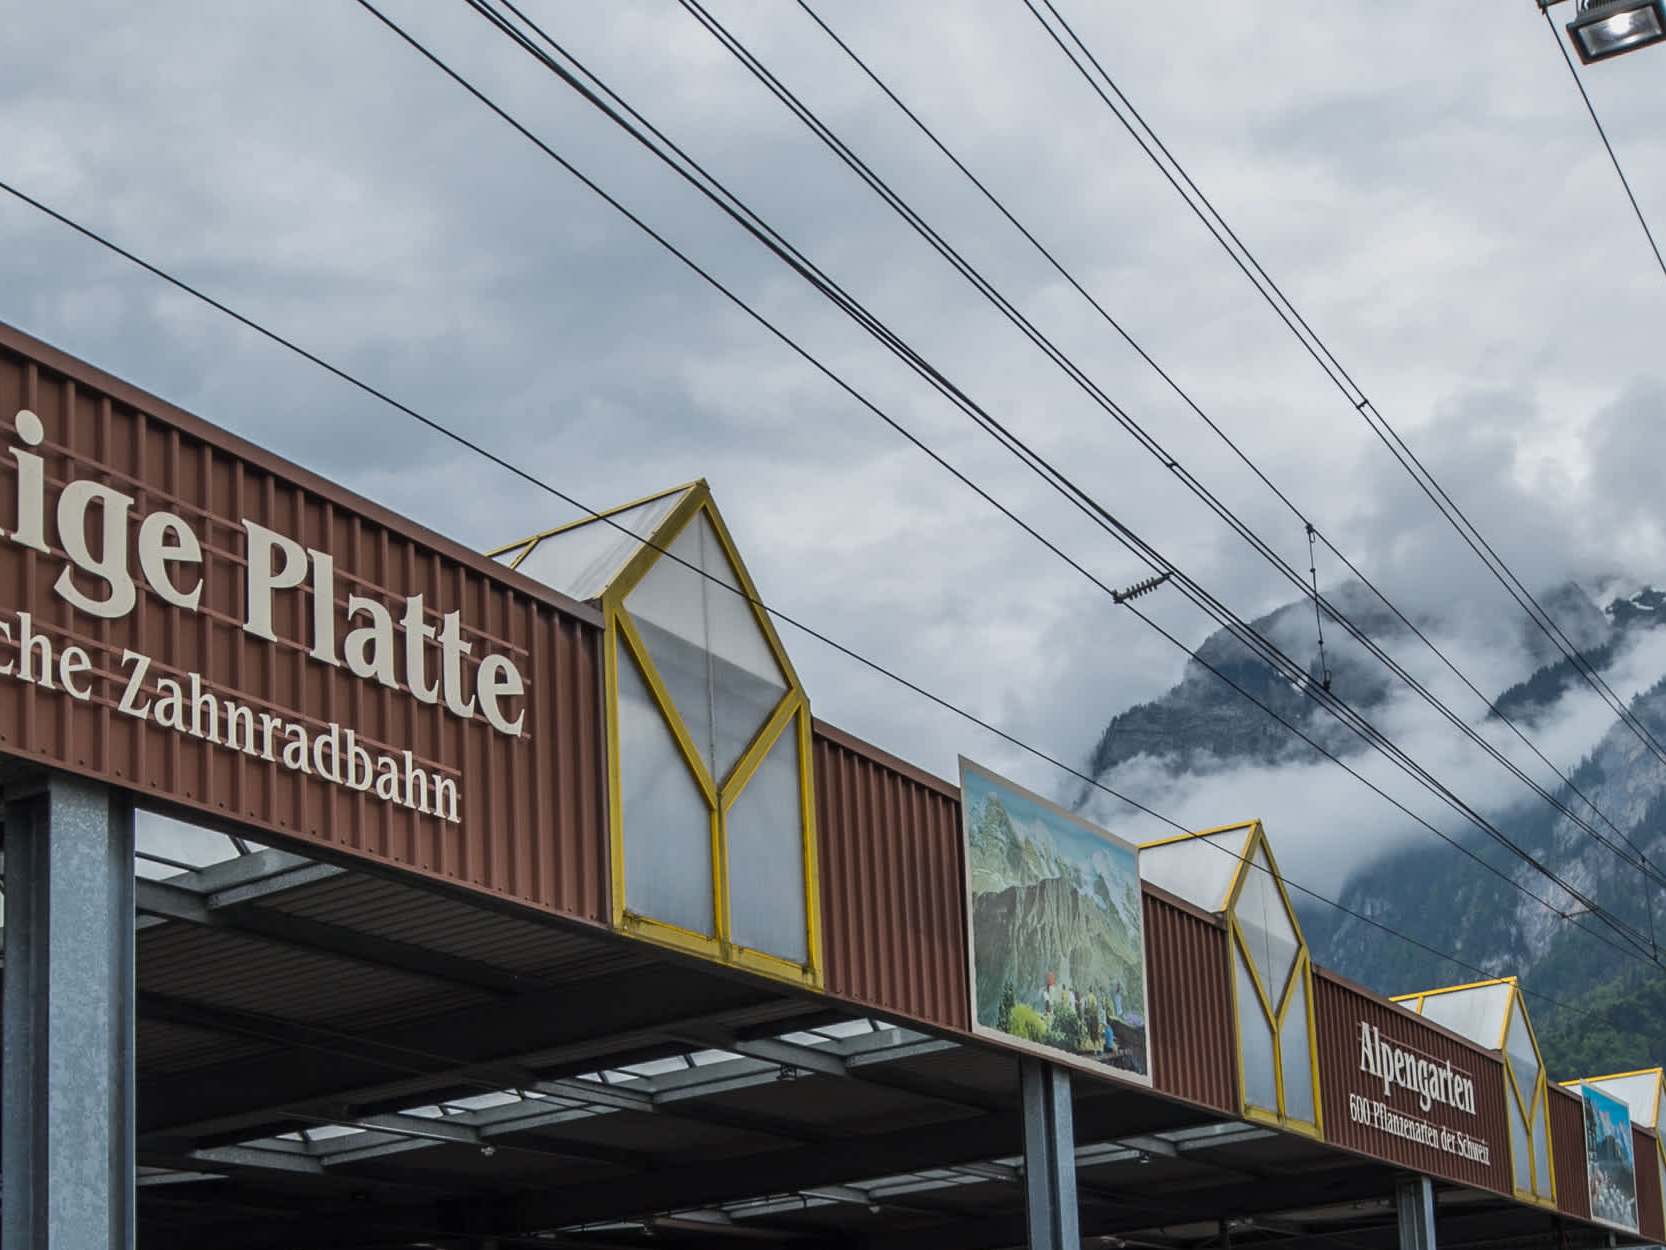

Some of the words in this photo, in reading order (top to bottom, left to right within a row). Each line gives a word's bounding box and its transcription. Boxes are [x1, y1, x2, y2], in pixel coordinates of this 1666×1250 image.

[241, 517, 527, 738] Platte
[118, 649, 462, 824] Zahnradbahn
[1349, 1093, 1371, 1126] 600
[1372, 1100, 1439, 1149] Pflanzenarten
[1440, 1125, 1456, 1154] der
[1456, 1131, 1491, 1167] Schweiz
[1359, 1021, 1477, 1116] Alpengarten
